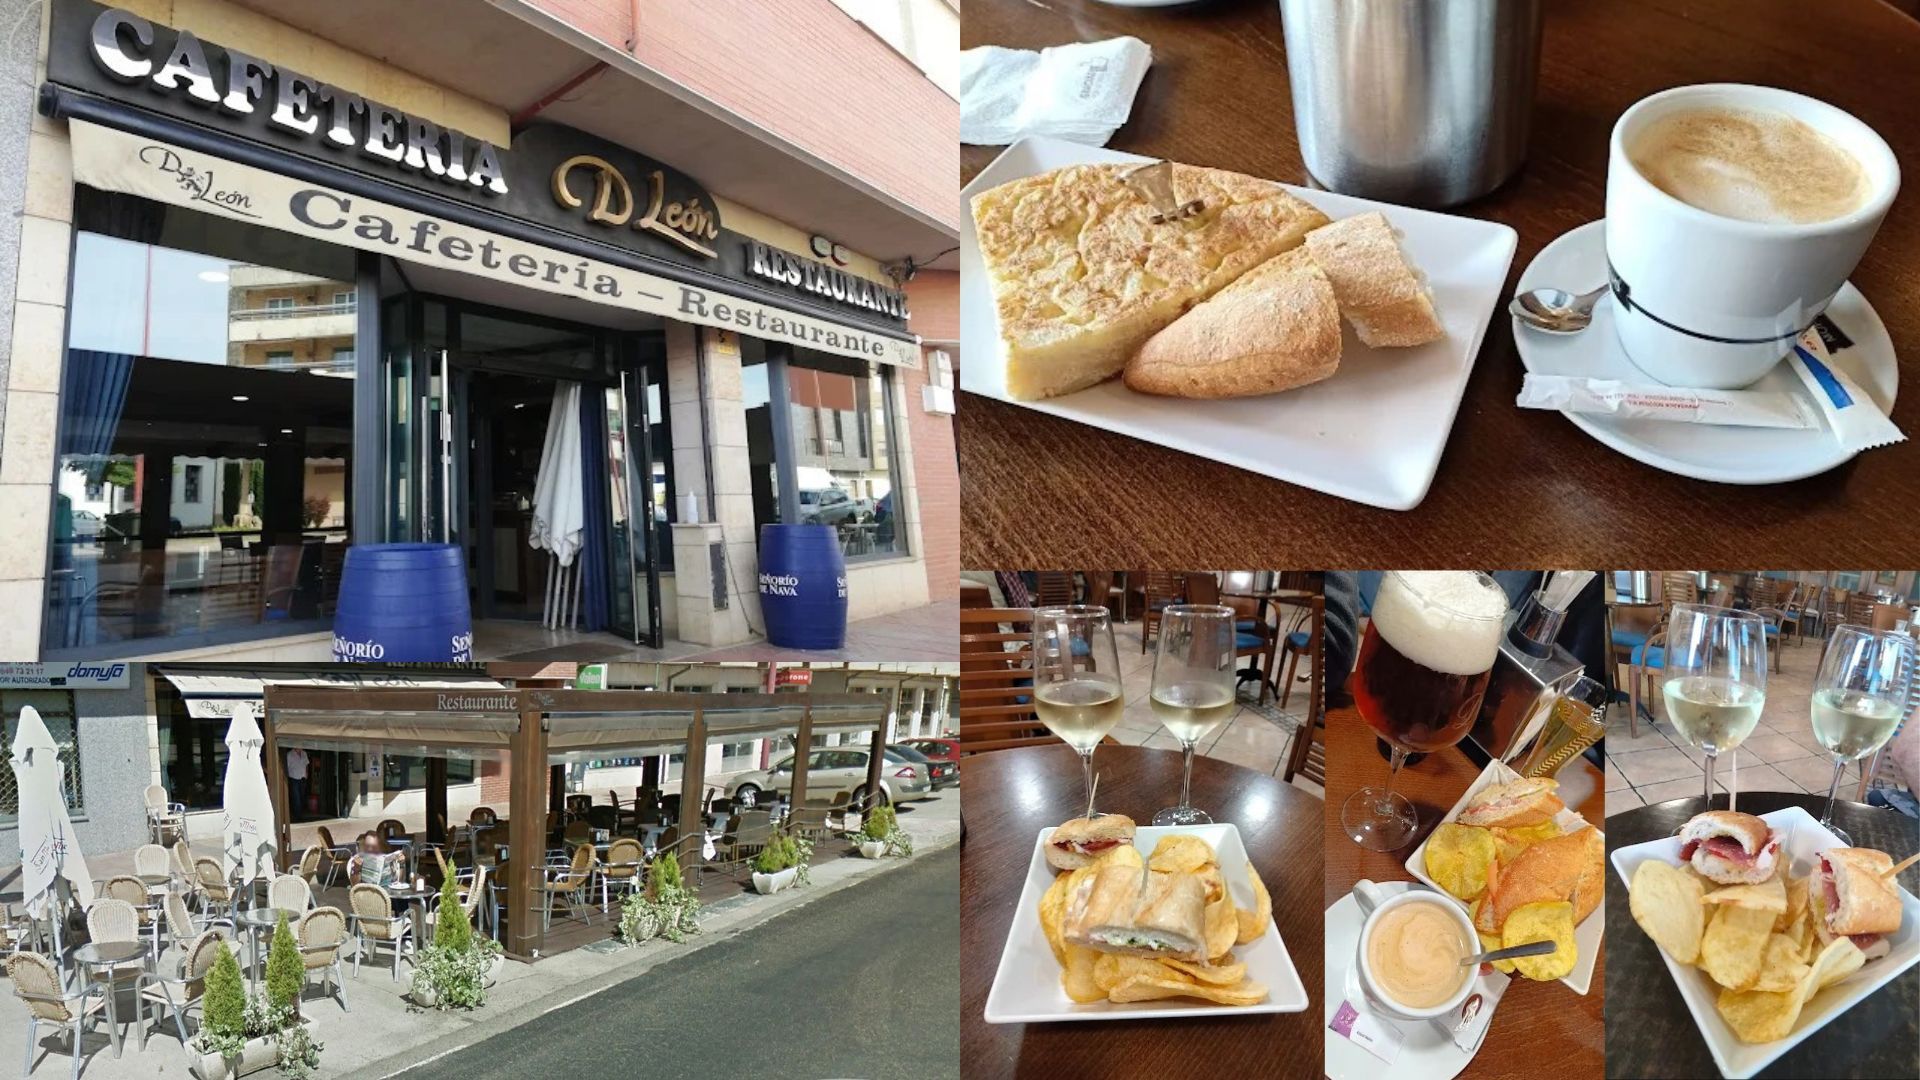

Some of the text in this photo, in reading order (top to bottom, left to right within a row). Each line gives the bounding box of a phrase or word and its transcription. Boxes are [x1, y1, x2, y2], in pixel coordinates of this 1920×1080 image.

[90, 8, 510, 194] CAFETERIA
[551, 155, 719, 259] D León
[289, 188, 622, 299] Cafetería
[678, 286, 885, 358] Restaurante
[744, 239, 911, 320] RESTAURANTE
[768, 585, 798, 597] NAVA
[437, 694, 517, 710] Restaurante
